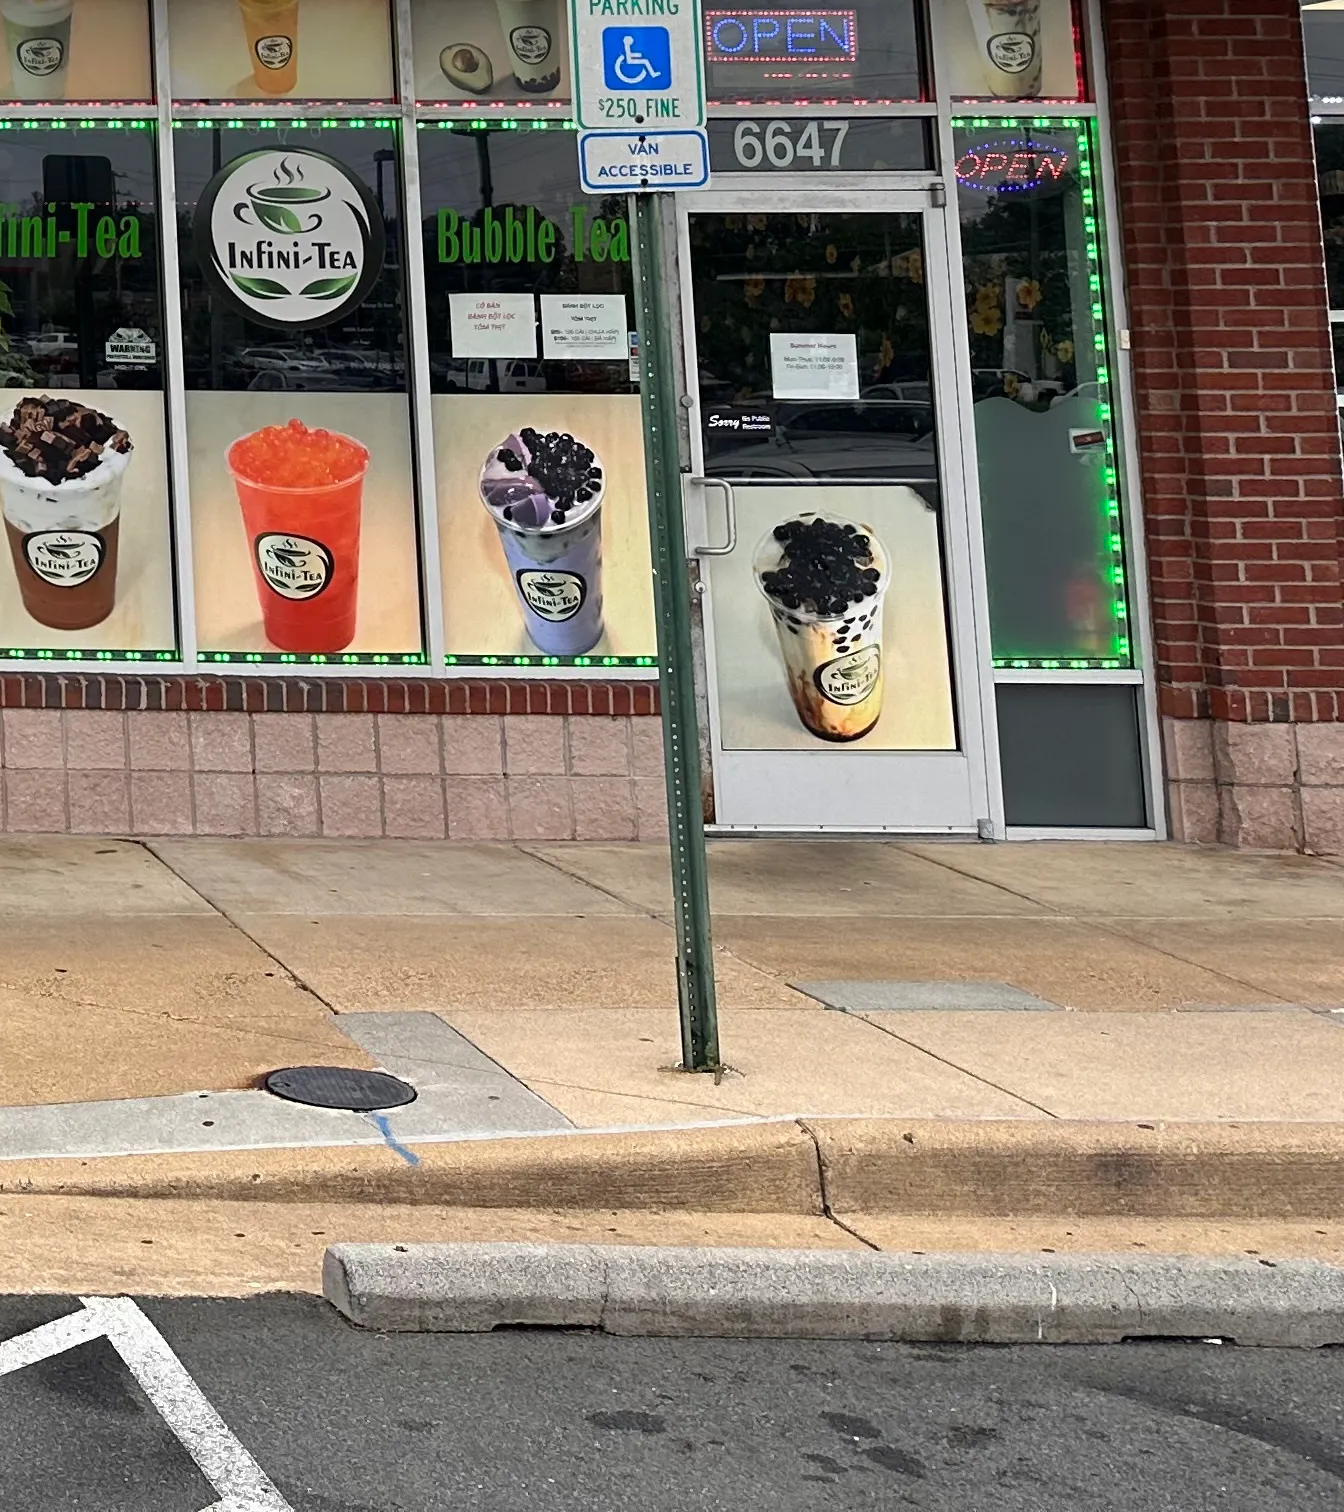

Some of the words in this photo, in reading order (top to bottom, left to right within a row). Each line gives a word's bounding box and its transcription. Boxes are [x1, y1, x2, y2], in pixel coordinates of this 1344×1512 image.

[713, 18, 849, 53] OPEN
[598, 98, 637, 118] $250
[647, 98, 680, 118] FINE
[627, 143, 659, 155] VAN
[733, 120, 850, 168] 6647
[598, 163, 693, 178] ACCESSIBLE
[954, 153, 1069, 179] OPEN
[437, 206, 555, 264] Bubble
[570, 206, 631, 262] Tea
[708, 414, 740, 430] Sorry
